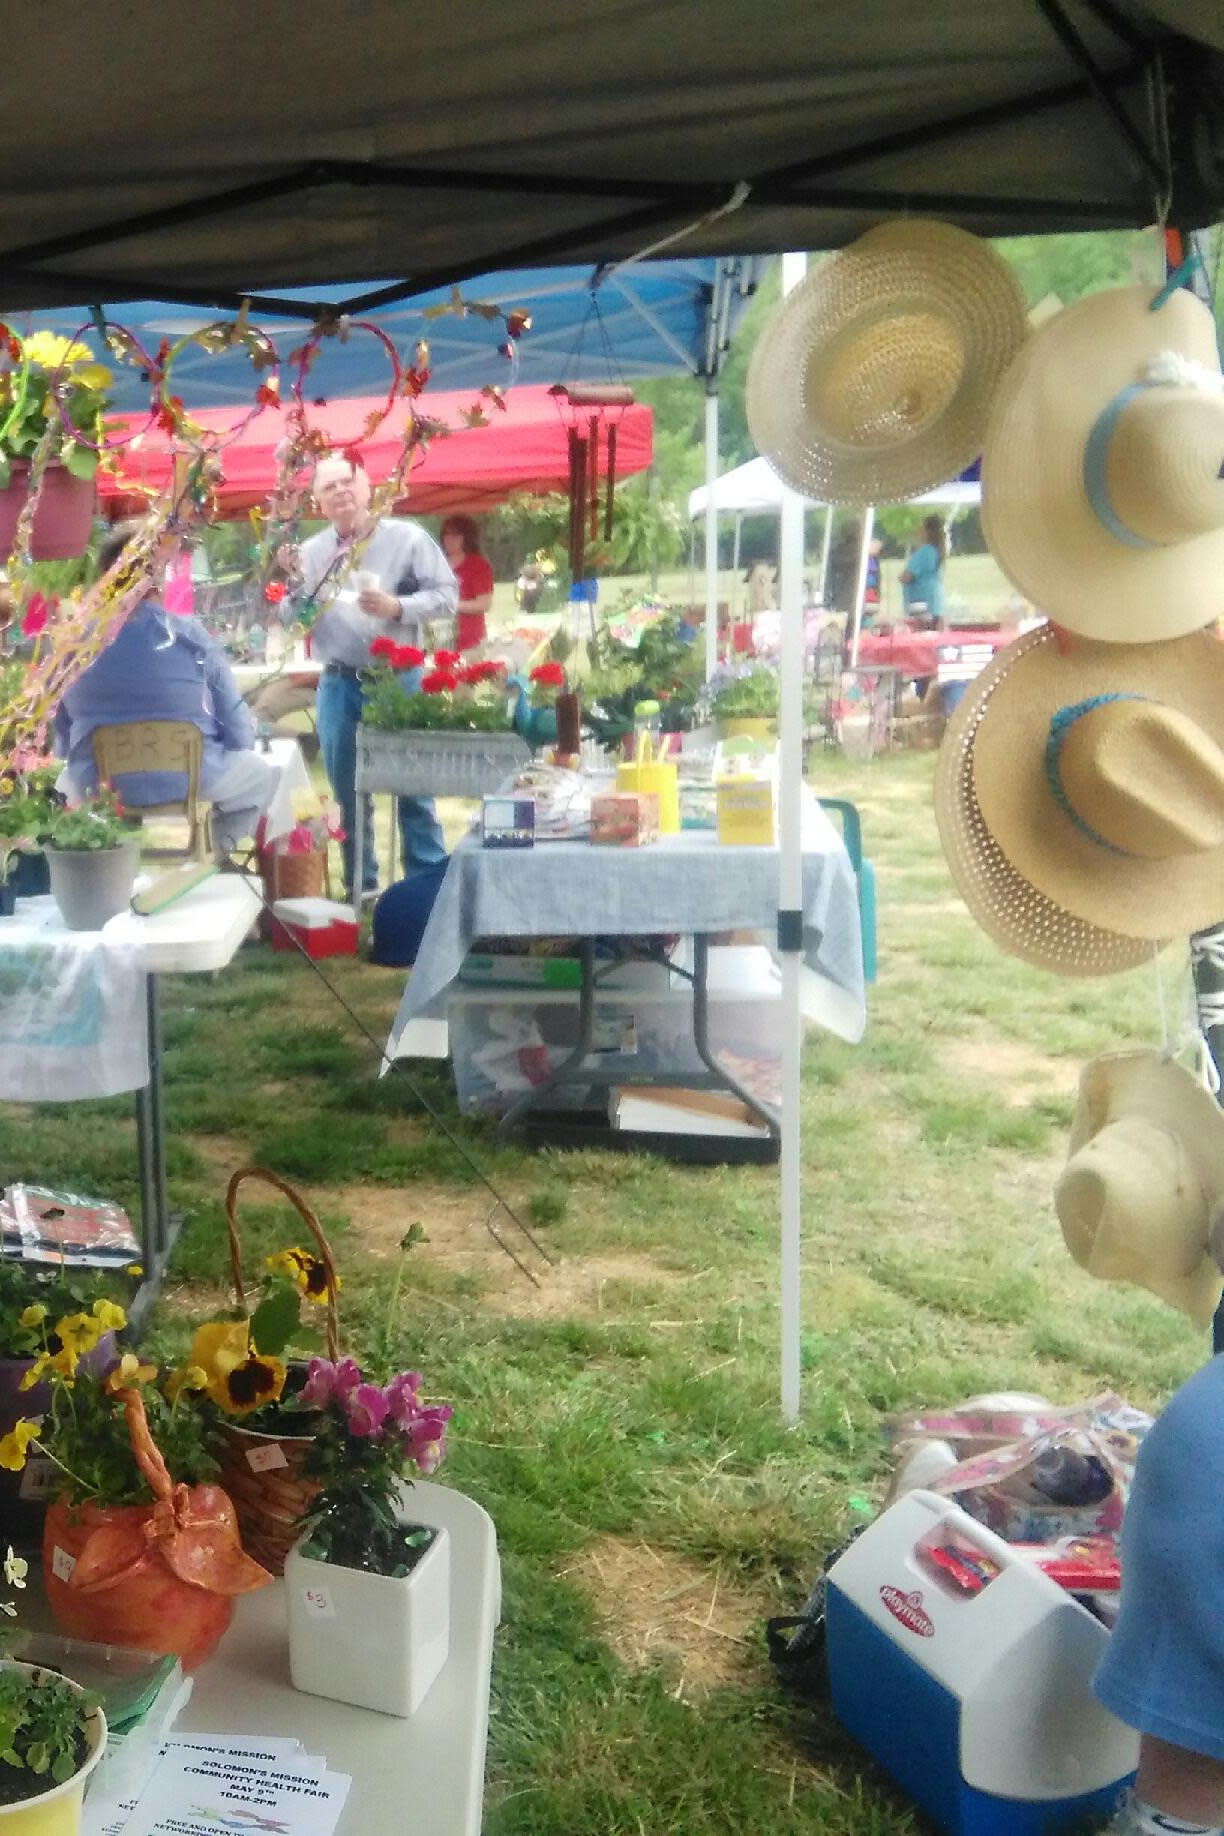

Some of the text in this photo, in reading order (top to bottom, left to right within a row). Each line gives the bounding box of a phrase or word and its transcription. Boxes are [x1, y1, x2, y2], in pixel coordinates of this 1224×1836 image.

[228, 1749, 276, 1761] MISSION
[183, 1766, 330, 1799] COMMUNITY HEALTH FAIR
[201, 1760, 319, 1787] SOLOMON'S MISSION
[229, 1784, 254, 1793] MAY
